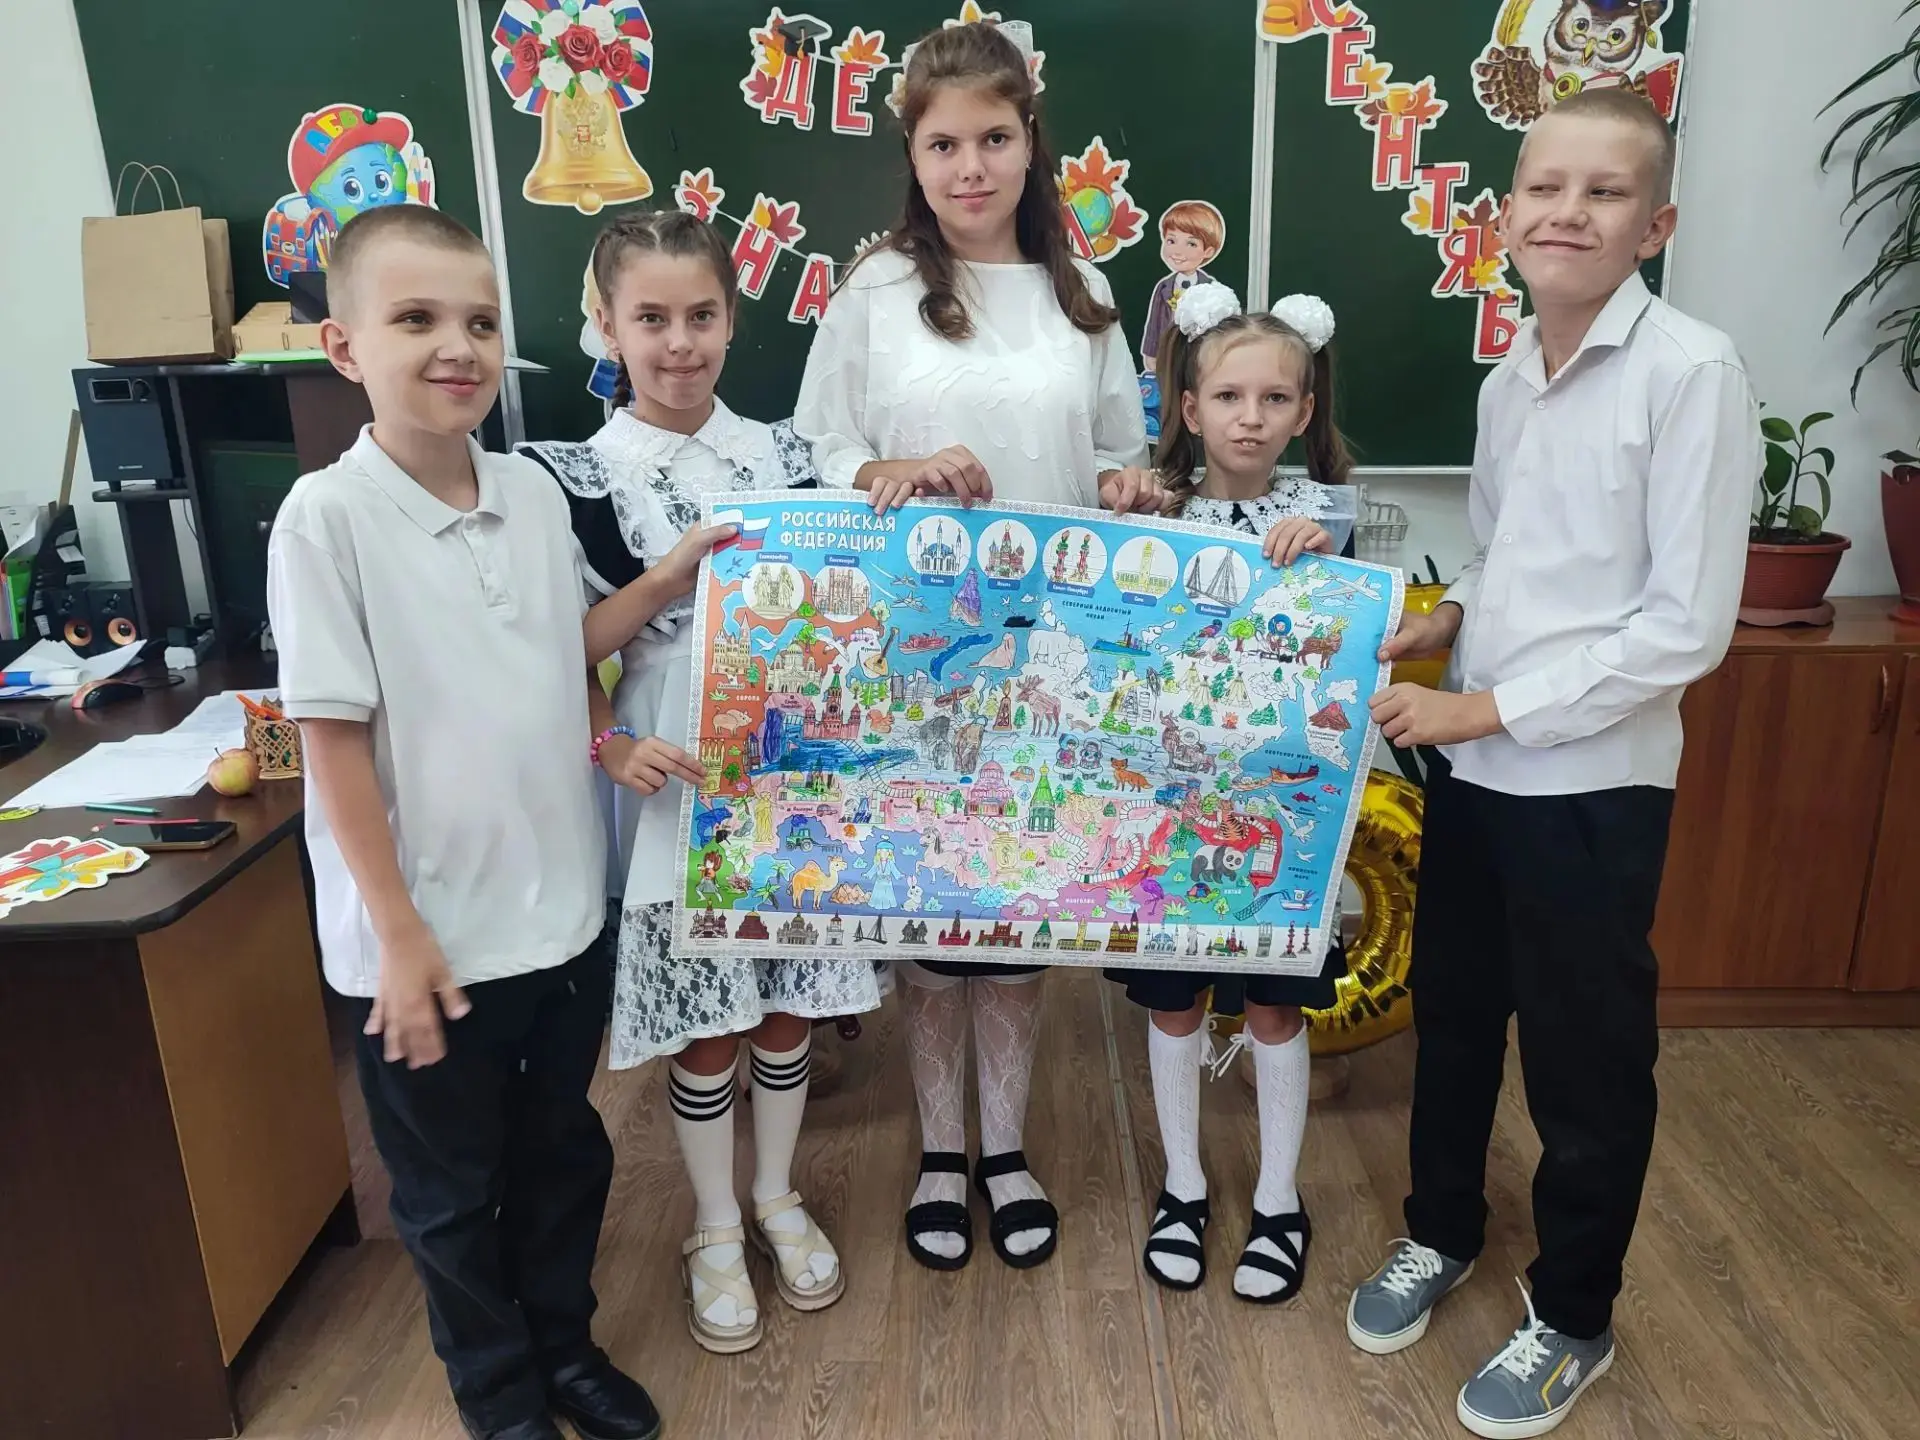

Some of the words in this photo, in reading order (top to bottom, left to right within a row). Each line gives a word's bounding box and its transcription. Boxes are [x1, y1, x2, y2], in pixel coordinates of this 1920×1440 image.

[781, 509, 896, 532] РОССИЙСКАЯ
[780, 531, 887, 552] ФЕДЕРАЦИЯ
[1062, 600, 1093, 610] СЕВЕРНЫЙ
